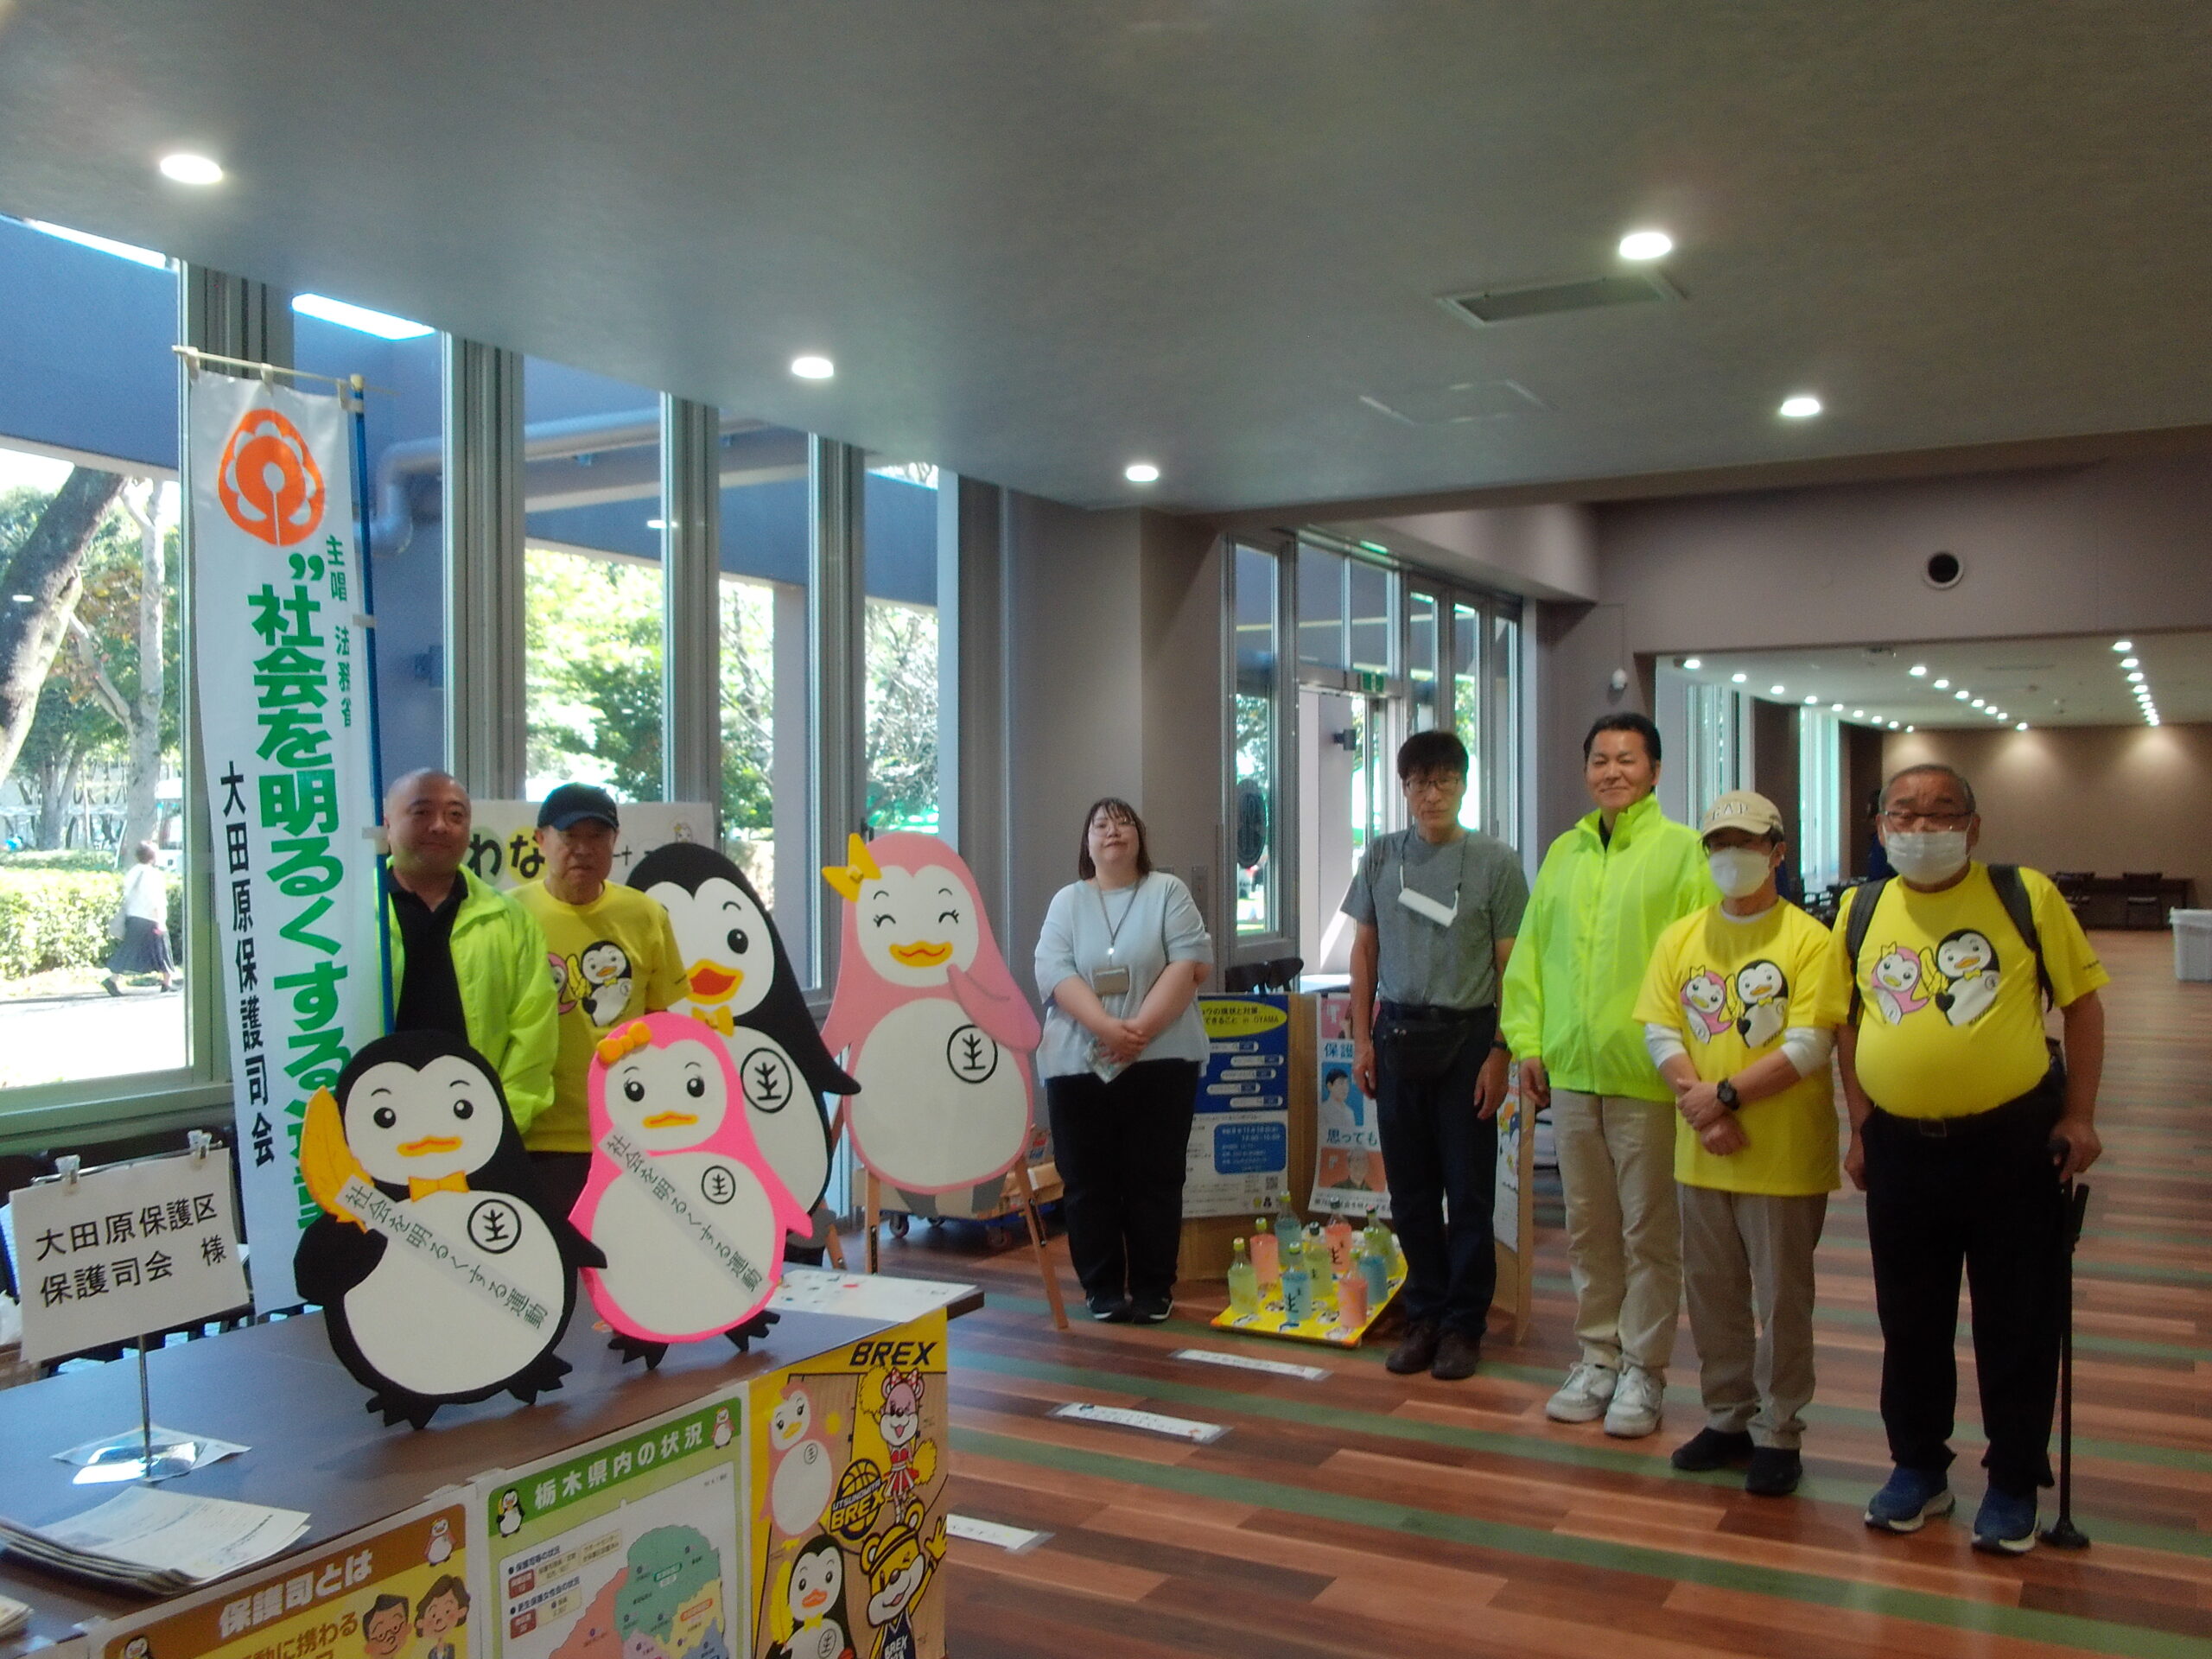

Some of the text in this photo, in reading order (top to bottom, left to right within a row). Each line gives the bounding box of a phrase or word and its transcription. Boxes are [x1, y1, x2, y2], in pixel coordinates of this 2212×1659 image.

[326, 534, 347, 602] 主唱
[219, 760, 275, 1168] 大田原保護司会
[35, 1192, 218, 1262] 大田原保護区
[607, 1134, 763, 1293] 社会を明るくする運動
[40, 1234, 227, 1307] 保護司会 様
[346, 1185, 548, 1330] 社会を明るくする運動
[849, 1341, 938, 1366] BREX
[534, 1421, 703, 1510] 栃木県内の状況
[830, 1480, 888, 1531] BREX
[219, 1548, 373, 1639] 保護司とは
